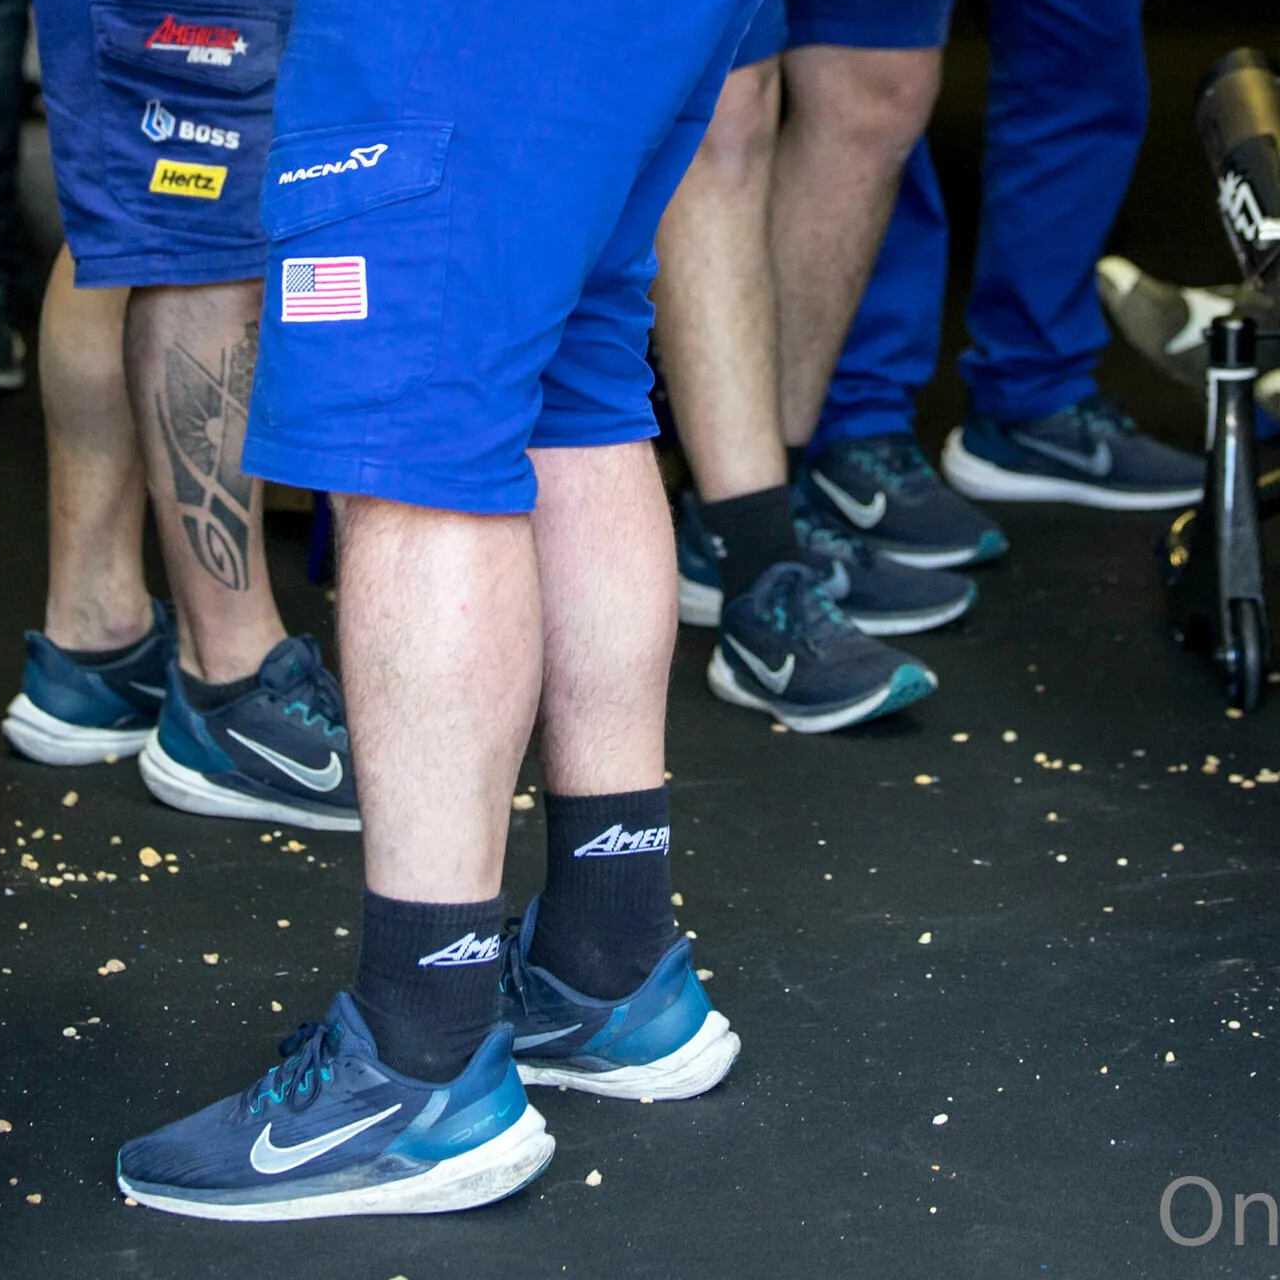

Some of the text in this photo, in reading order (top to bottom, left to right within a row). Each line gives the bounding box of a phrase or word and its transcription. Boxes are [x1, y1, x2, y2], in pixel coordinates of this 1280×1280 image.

[179, 120, 240, 150] BOSS
[161, 168, 217, 191] Hertz
[278, 156, 358, 185] MACNA
